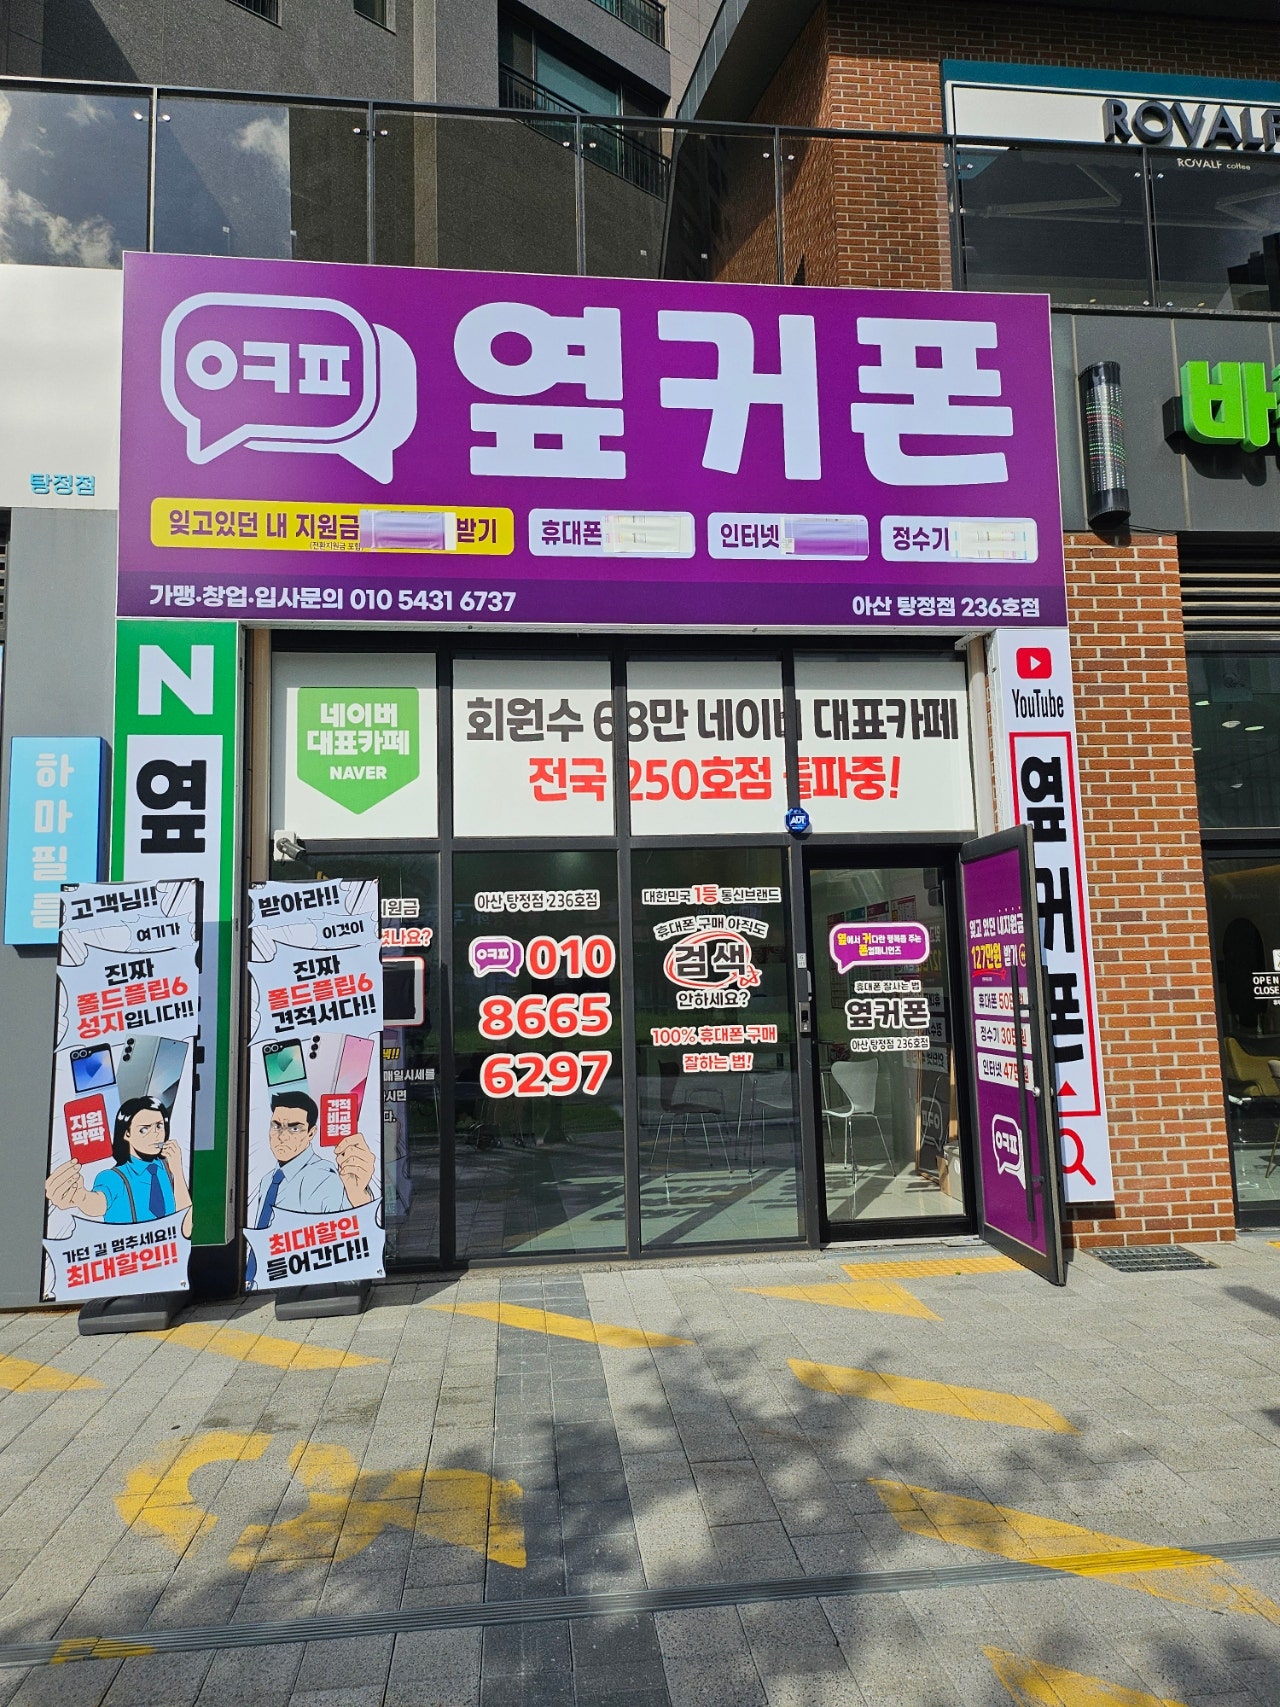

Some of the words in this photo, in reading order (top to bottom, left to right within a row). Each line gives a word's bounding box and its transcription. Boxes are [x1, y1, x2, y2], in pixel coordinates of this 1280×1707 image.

[1102, 99, 1280, 152] ROVALF
[1177, 158, 1222, 169] ROVALF
[453, 301, 1014, 486] 옆커폰
[1180, 361, 1280, 452] 바
[31, 474, 95, 496] 탕정점
[169, 509, 258, 538] 잊고있던
[266, 512, 287, 538] 내
[295, 513, 360, 540] 지원금
[456, 517, 497, 544] 받기
[541, 520, 602, 546] 휴대폰
[720, 523, 780, 549] 인터넷
[892, 526, 949, 552] 정수기
[350, 589, 392, 610] 010
[398, 590, 452, 611] 5431
[460, 591, 517, 612] 6737
[852, 596, 893, 616] 아산
[896, 597, 955, 617] 탕정점
[960, 597, 1040, 618] 236호점
[138, 645, 214, 715] N
[320, 703, 398, 728] 네이버
[1011, 688, 1064, 718] YouTube
[466, 697, 584, 742] 회원수
[813, 698, 959, 740] 대표카페
[307, 729, 410, 755] 대표카페
[329, 766, 387, 780] NAVER
[529, 757, 607, 802] 전국
[630, 757, 772, 801] 250호점
[790, 815, 806, 824] ADT
[71, 886, 158, 920] 고객님!!
[258, 885, 340, 918] 받아라!!
[478, 895, 502, 909] 아산
[507, 893, 544, 909] 탕정점
[549, 892, 597, 908] 236호점
[643, 890, 691, 903] 대한민국
[694, 886, 717, 903] 1등
[721, 889, 780, 902] 통신브랜드
[137, 922, 181, 942] 여기가
[322, 920, 364, 939] 이것이
[656, 919, 695, 938] 휴대폰
[698, 917, 724, 929] 구매
[728, 918, 766, 936] 아직도
[293, 955, 340, 982] 진짜
[529, 939, 612, 975] 010
[675, 944, 745, 977] 검색
[971, 942, 1002, 969] 127만원
[1003, 944, 1018, 967] 받기
[104, 958, 155, 986] 진짜
[1253, 976, 1279, 985] OPEN
[77, 976, 188, 1016] 폴드플립6
[267, 972, 374, 1011] 폴드플립6
[678, 991, 749, 1007] 안하세요?
[856, 982, 881, 991] 휴대폰
[911, 982, 919, 991] 법
[1254, 987, 1279, 995] CLOSE
[847, 1000, 928, 1027] 옆커폰
[979, 992, 997, 1009] 휴대폰
[77, 1000, 194, 1039] 성지입니다!!
[271, 994, 377, 1034] 견적서다!!
[482, 997, 608, 1035] 8665
[652, 1028, 696, 1044] 100%
[700, 1028, 743, 1042] 휴대폰
[747, 1026, 776, 1041] 구매
[852, 1040, 868, 1050] 아산
[870, 1039, 894, 1050] 탕정점
[897, 1037, 928, 1049] 236호점
[980, 1026, 999, 1043] 정수기
[484, 1055, 608, 1094] 6297
[684, 1056, 728, 1070] 잘하는
[731, 1054, 752, 1069] 법!
[983, 1059, 1002, 1077] 인터넷
[327, 1098, 352, 1112] 견적
[327, 1110, 352, 1124] 비교
[70, 1110, 103, 1130] 지원
[62, 1245, 90, 1264] 가던
[94, 1243, 108, 1256] 길
[111, 1226, 177, 1252] 멈추세요!!
[269, 1215, 360, 1256] 최대할인
[67, 1242, 179, 1289] 최대할인!!
[266, 1236, 370, 1282] 들어간다!!
